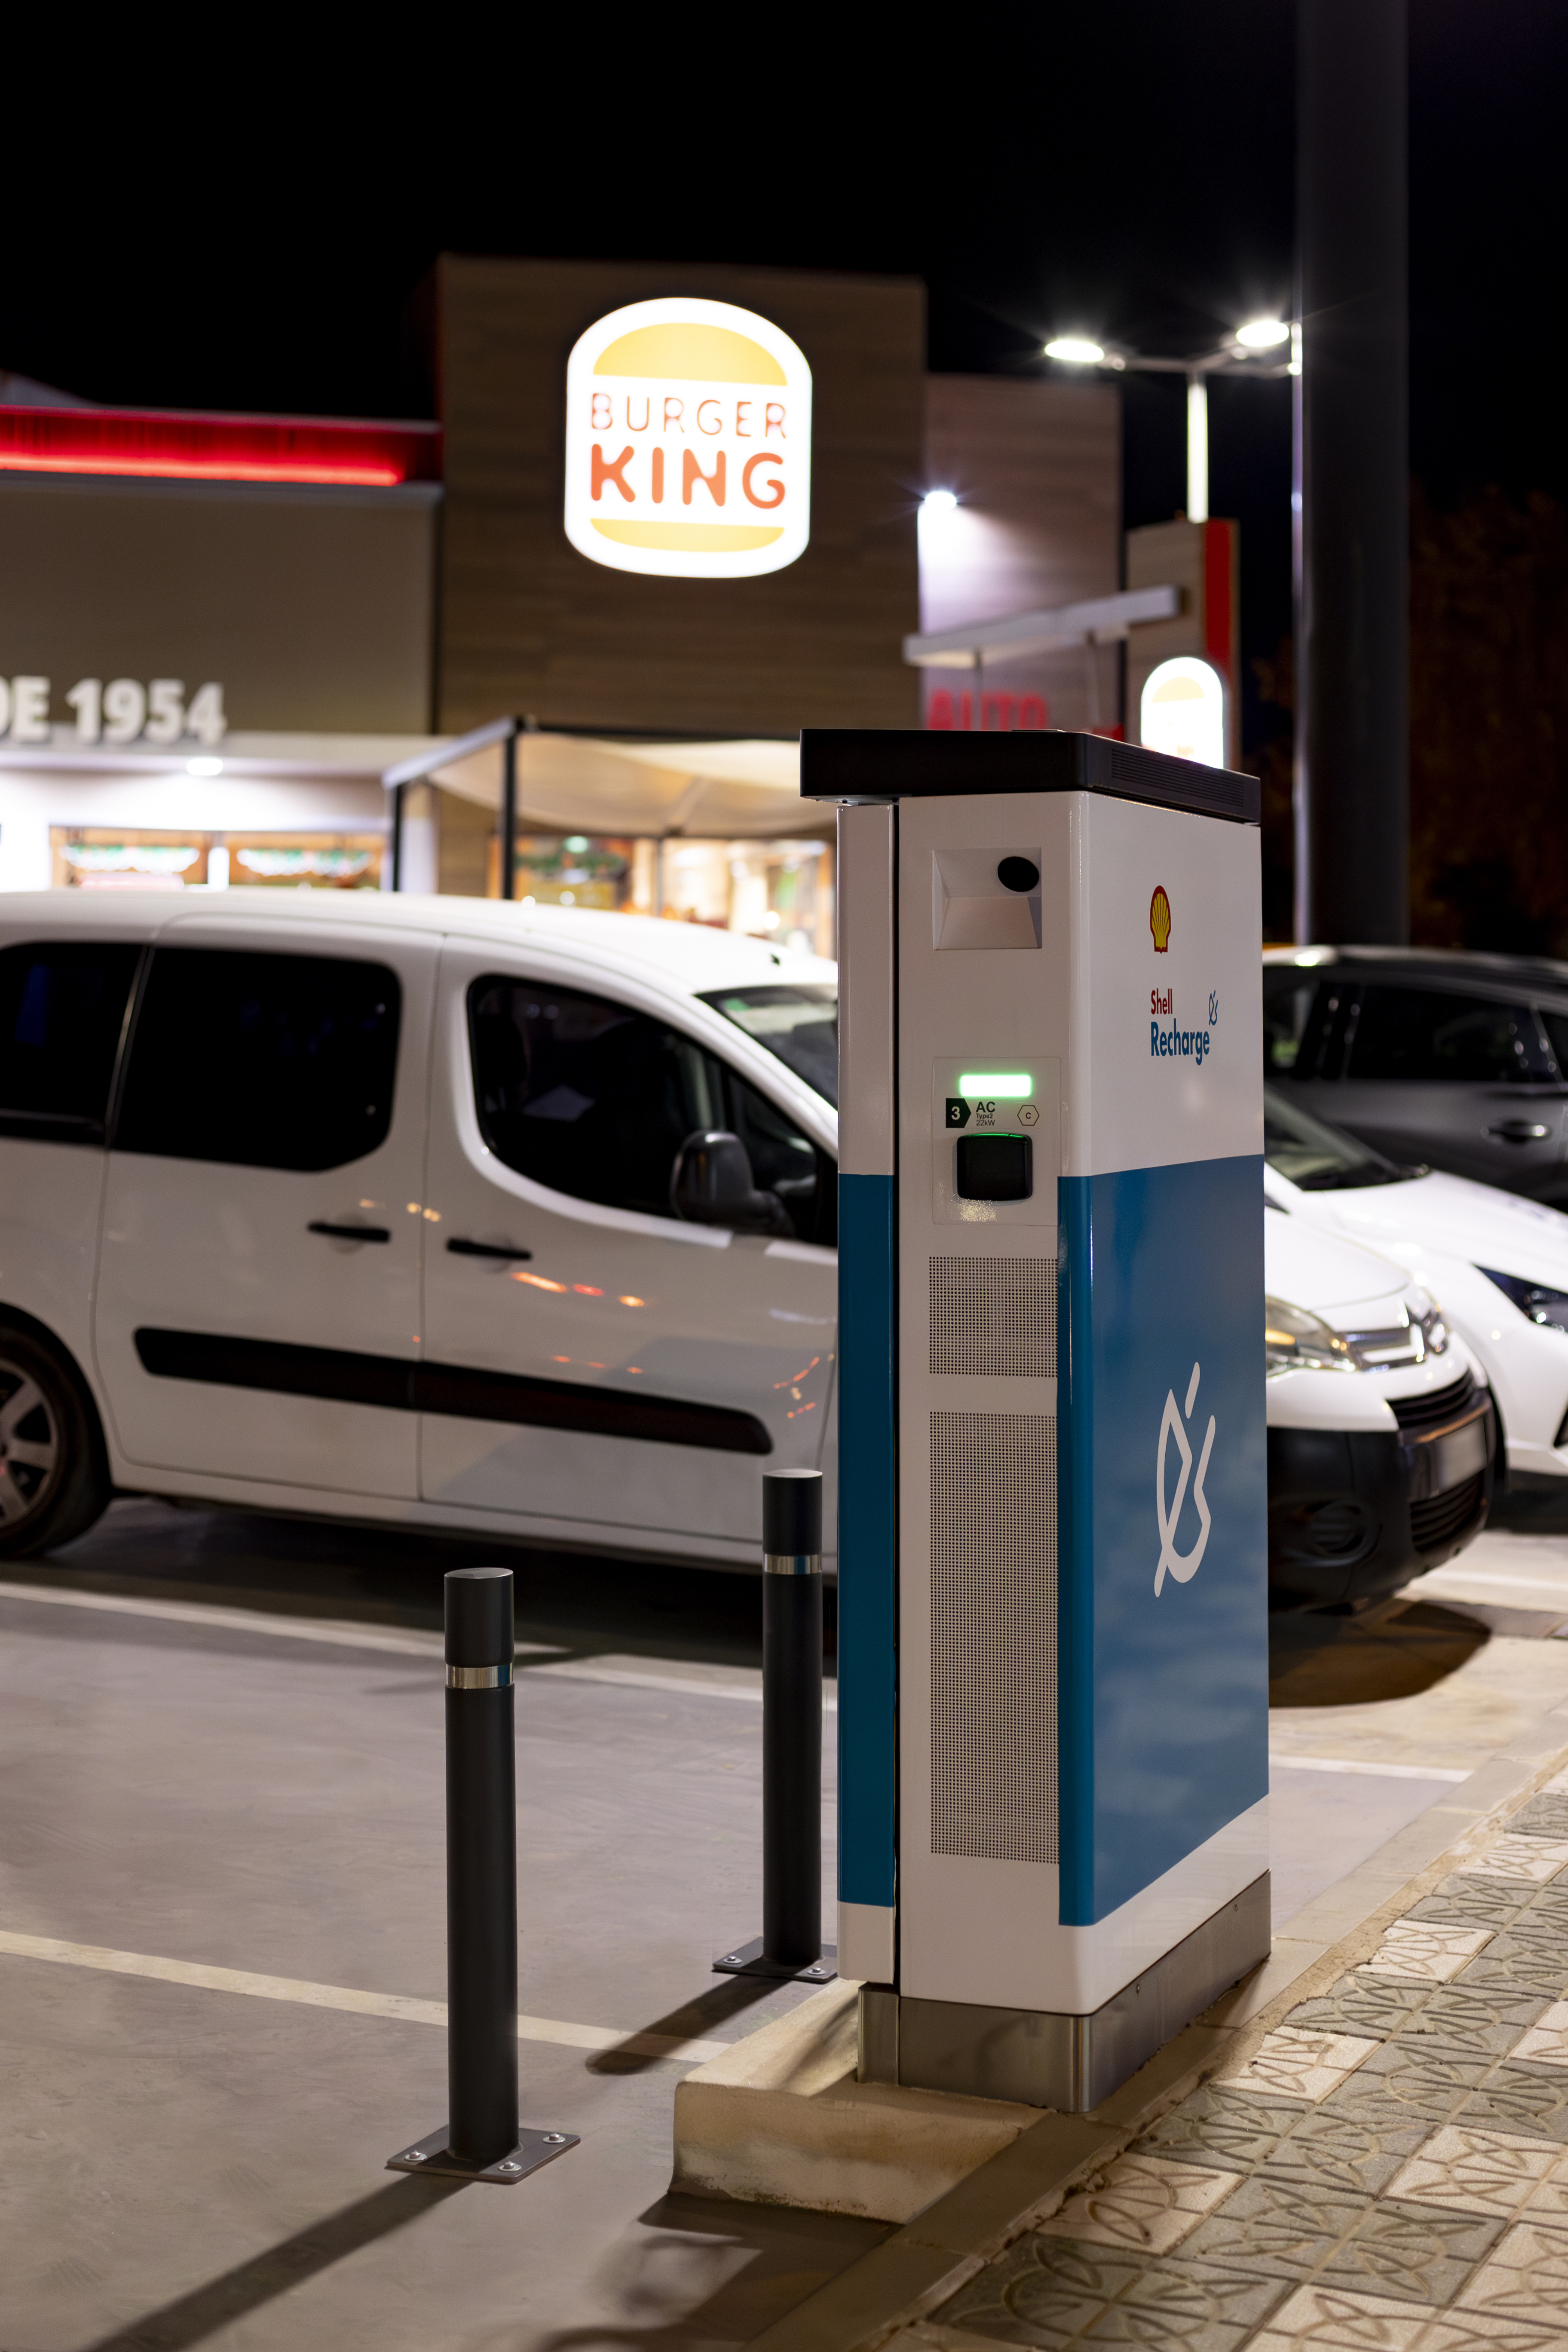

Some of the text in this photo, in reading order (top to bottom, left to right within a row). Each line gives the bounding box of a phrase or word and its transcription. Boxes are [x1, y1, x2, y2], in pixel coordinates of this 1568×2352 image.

[591, 393, 786, 439] BURGER
[591, 443, 786, 509] KING
[64, 677, 228, 747] 1954
[1151, 988, 1173, 1015] Shell
[1151, 1018, 1210, 1066] Recharge
[951, 1106, 960, 1120] 3
[976, 1101, 995, 1113] AC
